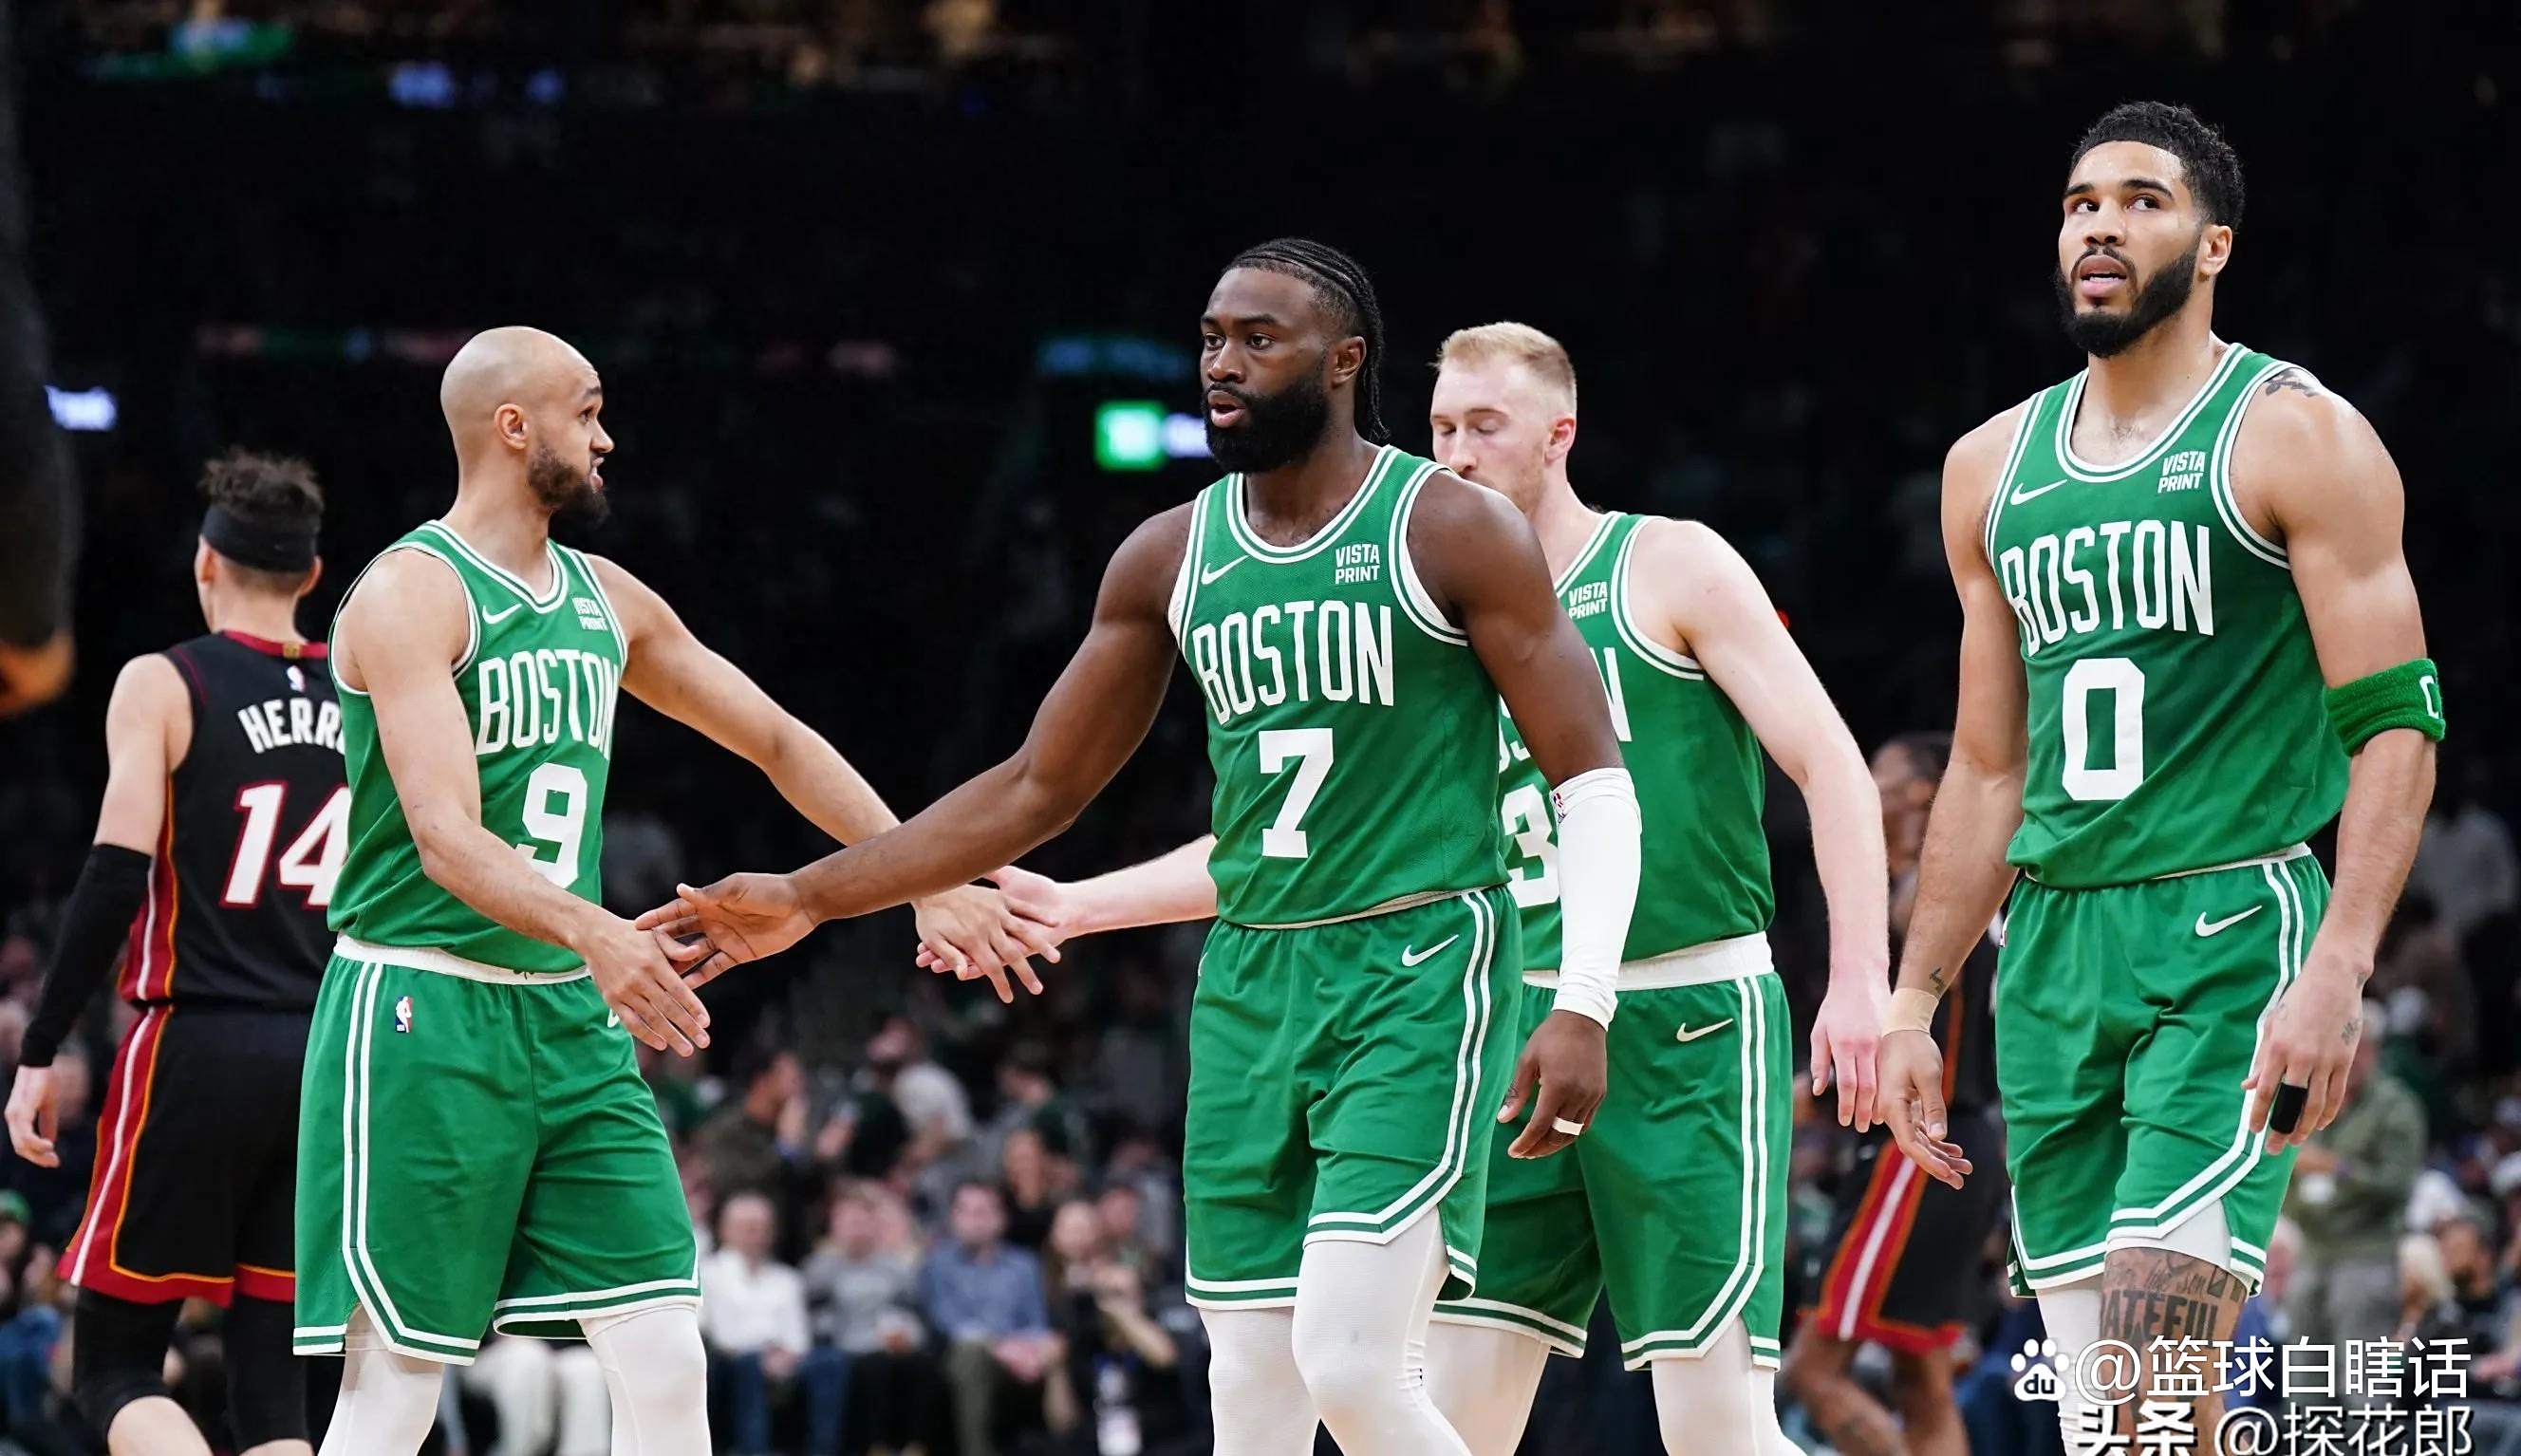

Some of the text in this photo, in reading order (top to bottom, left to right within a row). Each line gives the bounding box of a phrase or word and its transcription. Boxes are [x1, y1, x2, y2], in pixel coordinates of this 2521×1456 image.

[2157, 473, 2204, 494] PRINT
[2162, 451, 2206, 476] VISTA
[1335, 543, 1380, 569] VISTA
[1335, 565, 1380, 585] PRINT
[1568, 581, 1608, 607] VISTA
[1568, 597, 1608, 620] PRINT
[1999, 519, 2214, 658] BOSTON
[476, 648, 619, 762] BOSTON
[1192, 600, 1394, 726] BOSTON
[2062, 657, 2145, 802] 0
[219, 780, 352, 909] 14
[514, 762, 588, 889] 9
[1258, 727, 1335, 859] 7
